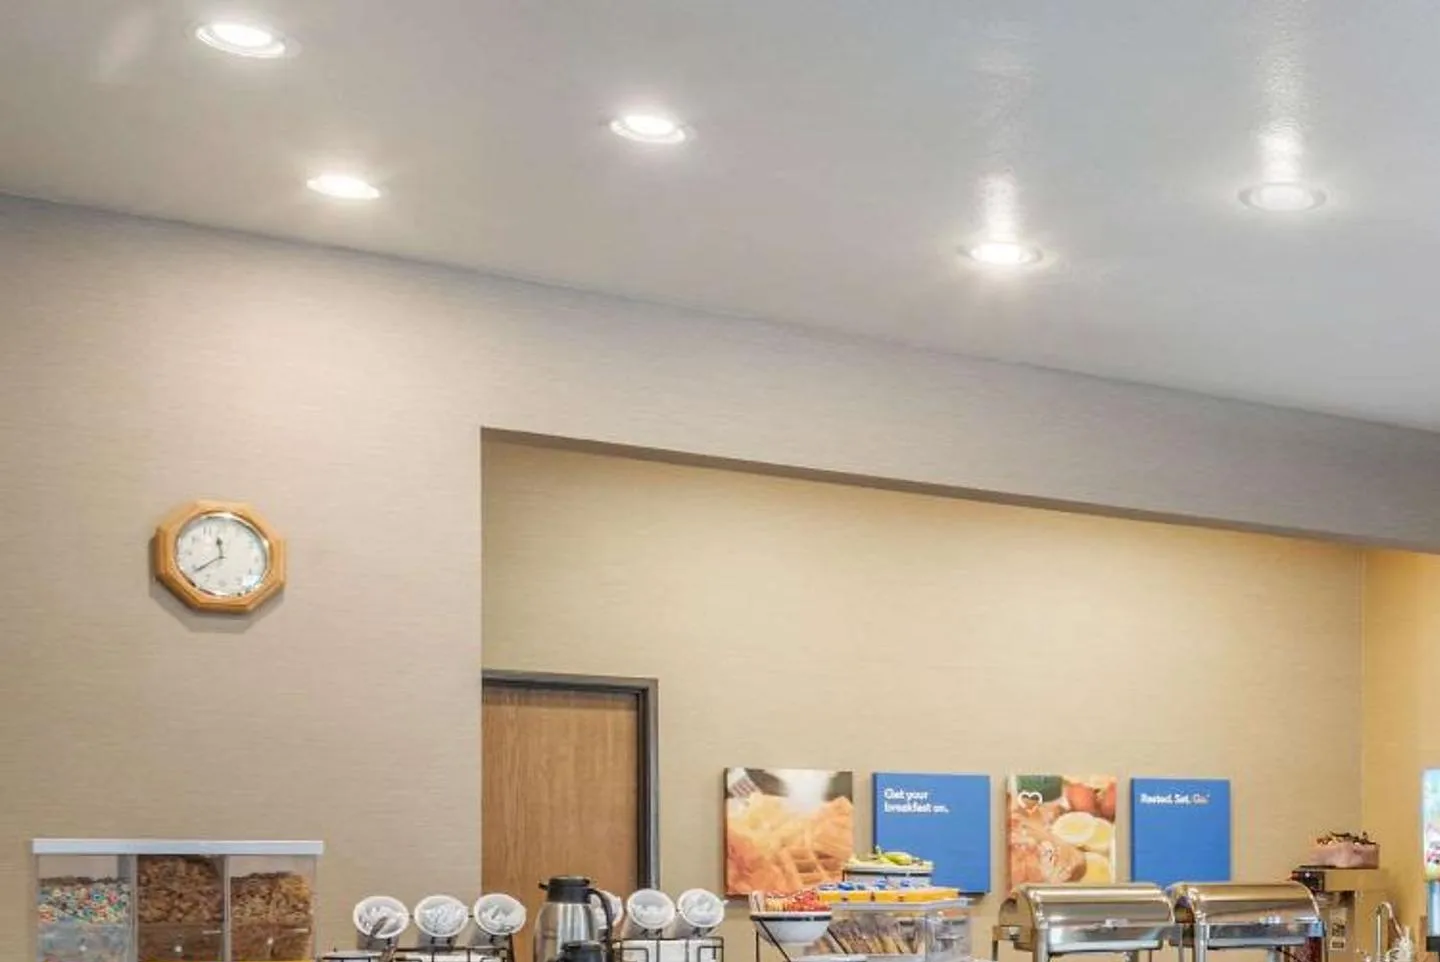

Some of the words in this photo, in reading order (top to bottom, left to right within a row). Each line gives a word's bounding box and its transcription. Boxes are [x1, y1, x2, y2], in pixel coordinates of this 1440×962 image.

[884, 787, 904, 800] Get
[905, 790, 929, 802] your
[884, 801, 931, 813] breakfast
